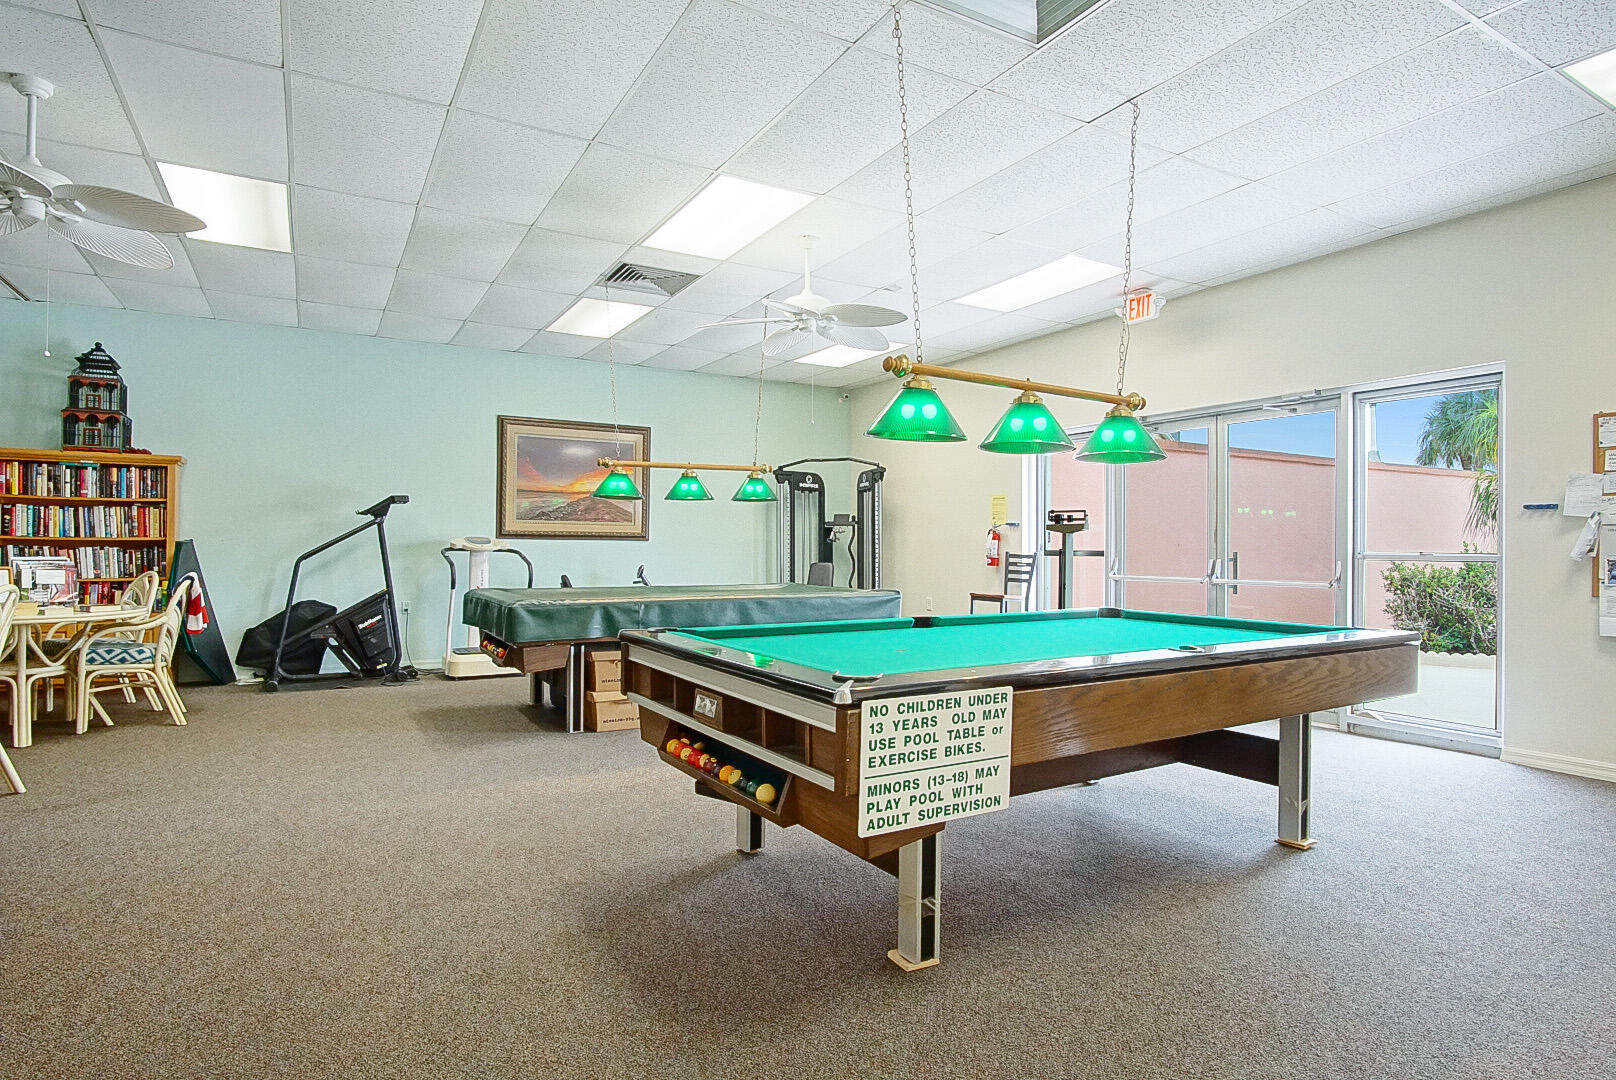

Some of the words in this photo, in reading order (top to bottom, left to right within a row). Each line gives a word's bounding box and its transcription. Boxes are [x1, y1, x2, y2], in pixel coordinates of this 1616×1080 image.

[1129, 293, 1152, 320] EXIT
[869, 704, 889, 718] NO
[896, 697, 962, 715] CHILDREN
[968, 692, 1008, 707] UNDER
[868, 722, 884, 734] 13
[892, 715, 938, 732] YEARS
[951, 711, 976, 725] OLD
[982, 707, 1008, 720] MAY
[868, 737, 897, 751] USE
[904, 732, 940, 746] POOL
[947, 726, 986, 741] TABLE
[991, 725, 1004, 735] or
[868, 748, 938, 769] EXERCISE
[944, 742, 986, 758] BIKES.
[867, 778, 920, 798] MINORS
[927, 770, 969, 790] (13-18)
[975, 765, 1000, 780] MAY
[866, 798, 901, 815] PLAY
[909, 791, 944, 807] POOL
[952, 783, 984, 799] WITH
[866, 812, 910, 831] ADULT
[917, 795, 1001, 821] SUPERVISION
